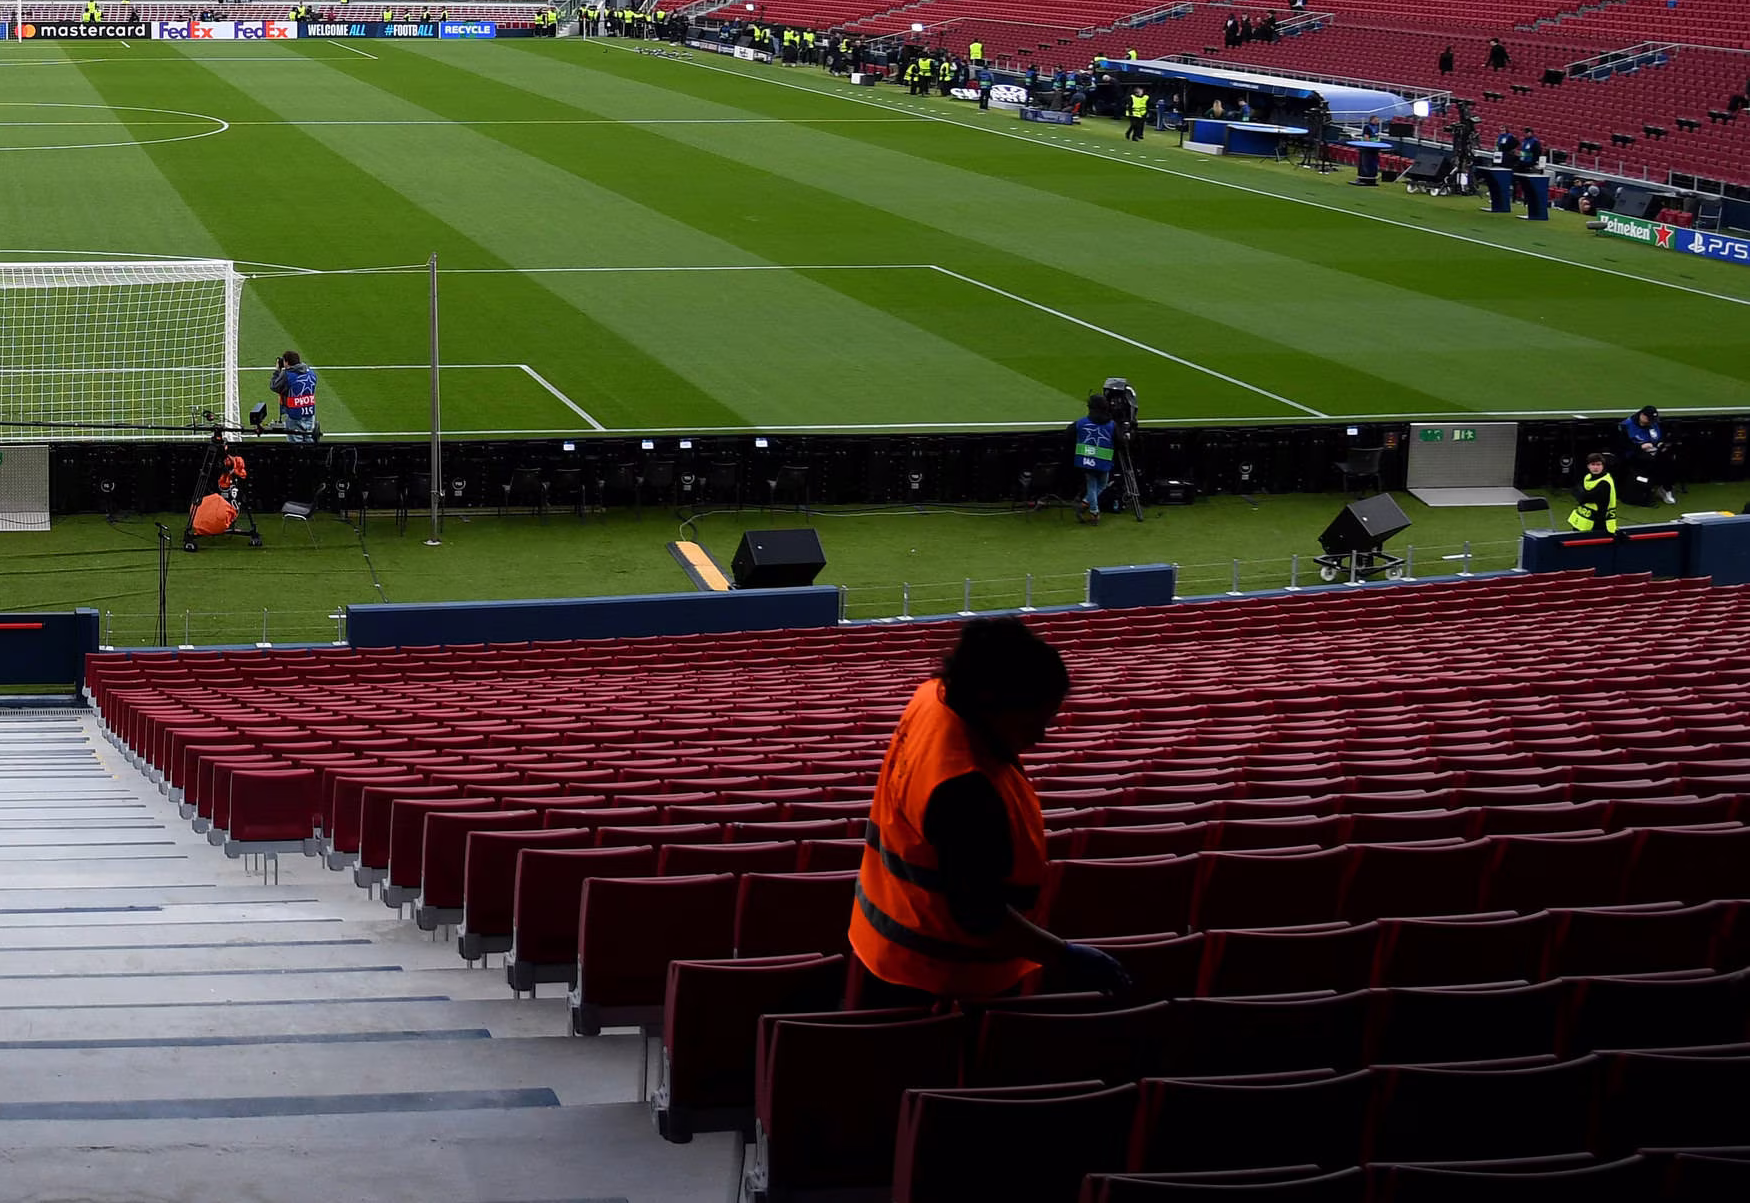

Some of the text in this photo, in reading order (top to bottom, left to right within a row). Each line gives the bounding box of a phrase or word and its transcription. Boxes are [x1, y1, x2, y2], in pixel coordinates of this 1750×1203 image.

[41, 22, 146, 38] mastercard
[159, 21, 214, 39] FedEx
[234, 20, 289, 39] FedEx
[308, 24, 366, 36] WELCOME ALL
[384, 24, 434, 37] #FOOTBALL
[445, 26, 491, 34] RECYCLE
[1708, 238, 1749, 260] PS5
